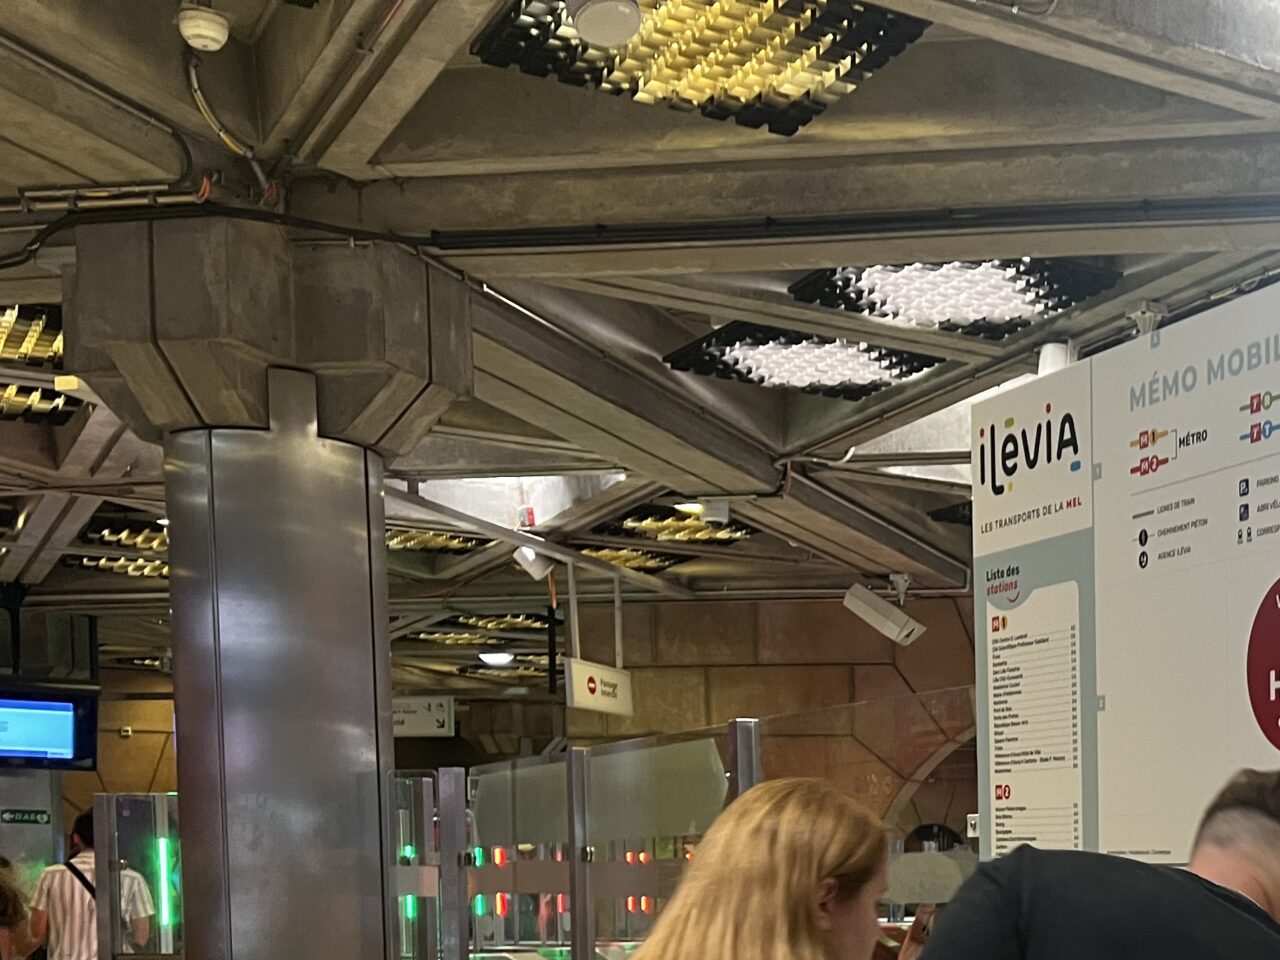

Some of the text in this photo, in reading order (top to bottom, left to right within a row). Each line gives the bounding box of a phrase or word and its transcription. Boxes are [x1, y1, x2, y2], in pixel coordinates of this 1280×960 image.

[1129, 364, 1198, 412] MÉMO
[980, 496, 1082, 534] LES TRANSPORTS DE LA MEL
[986, 564, 1020, 582] Liste des
[987, 579, 1018, 596] stations
